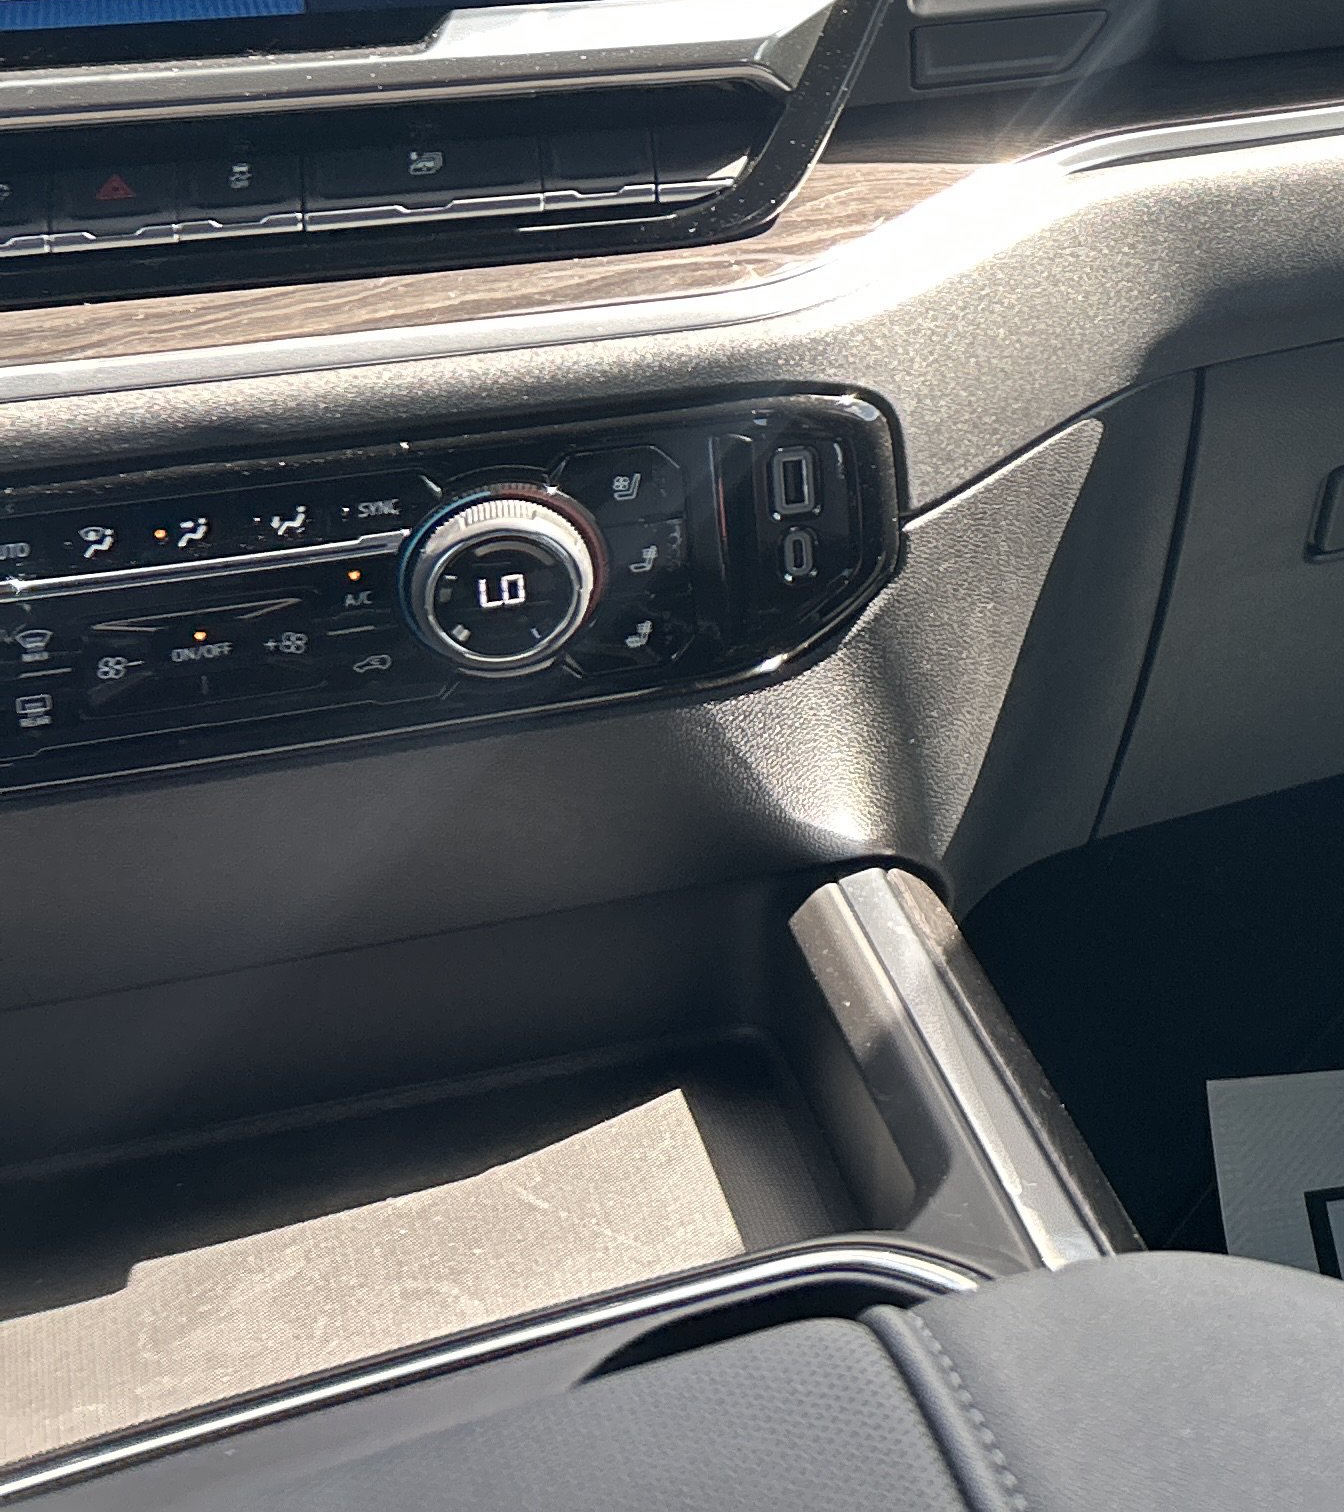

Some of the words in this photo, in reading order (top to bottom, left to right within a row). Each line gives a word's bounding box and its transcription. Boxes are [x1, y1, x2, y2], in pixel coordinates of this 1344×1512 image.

[357, 498, 401, 519] SYNC
[0, 542, 32, 560] UTO
[344, 590, 374, 608] A/C
[171, 641, 233, 663] ON/OFF
